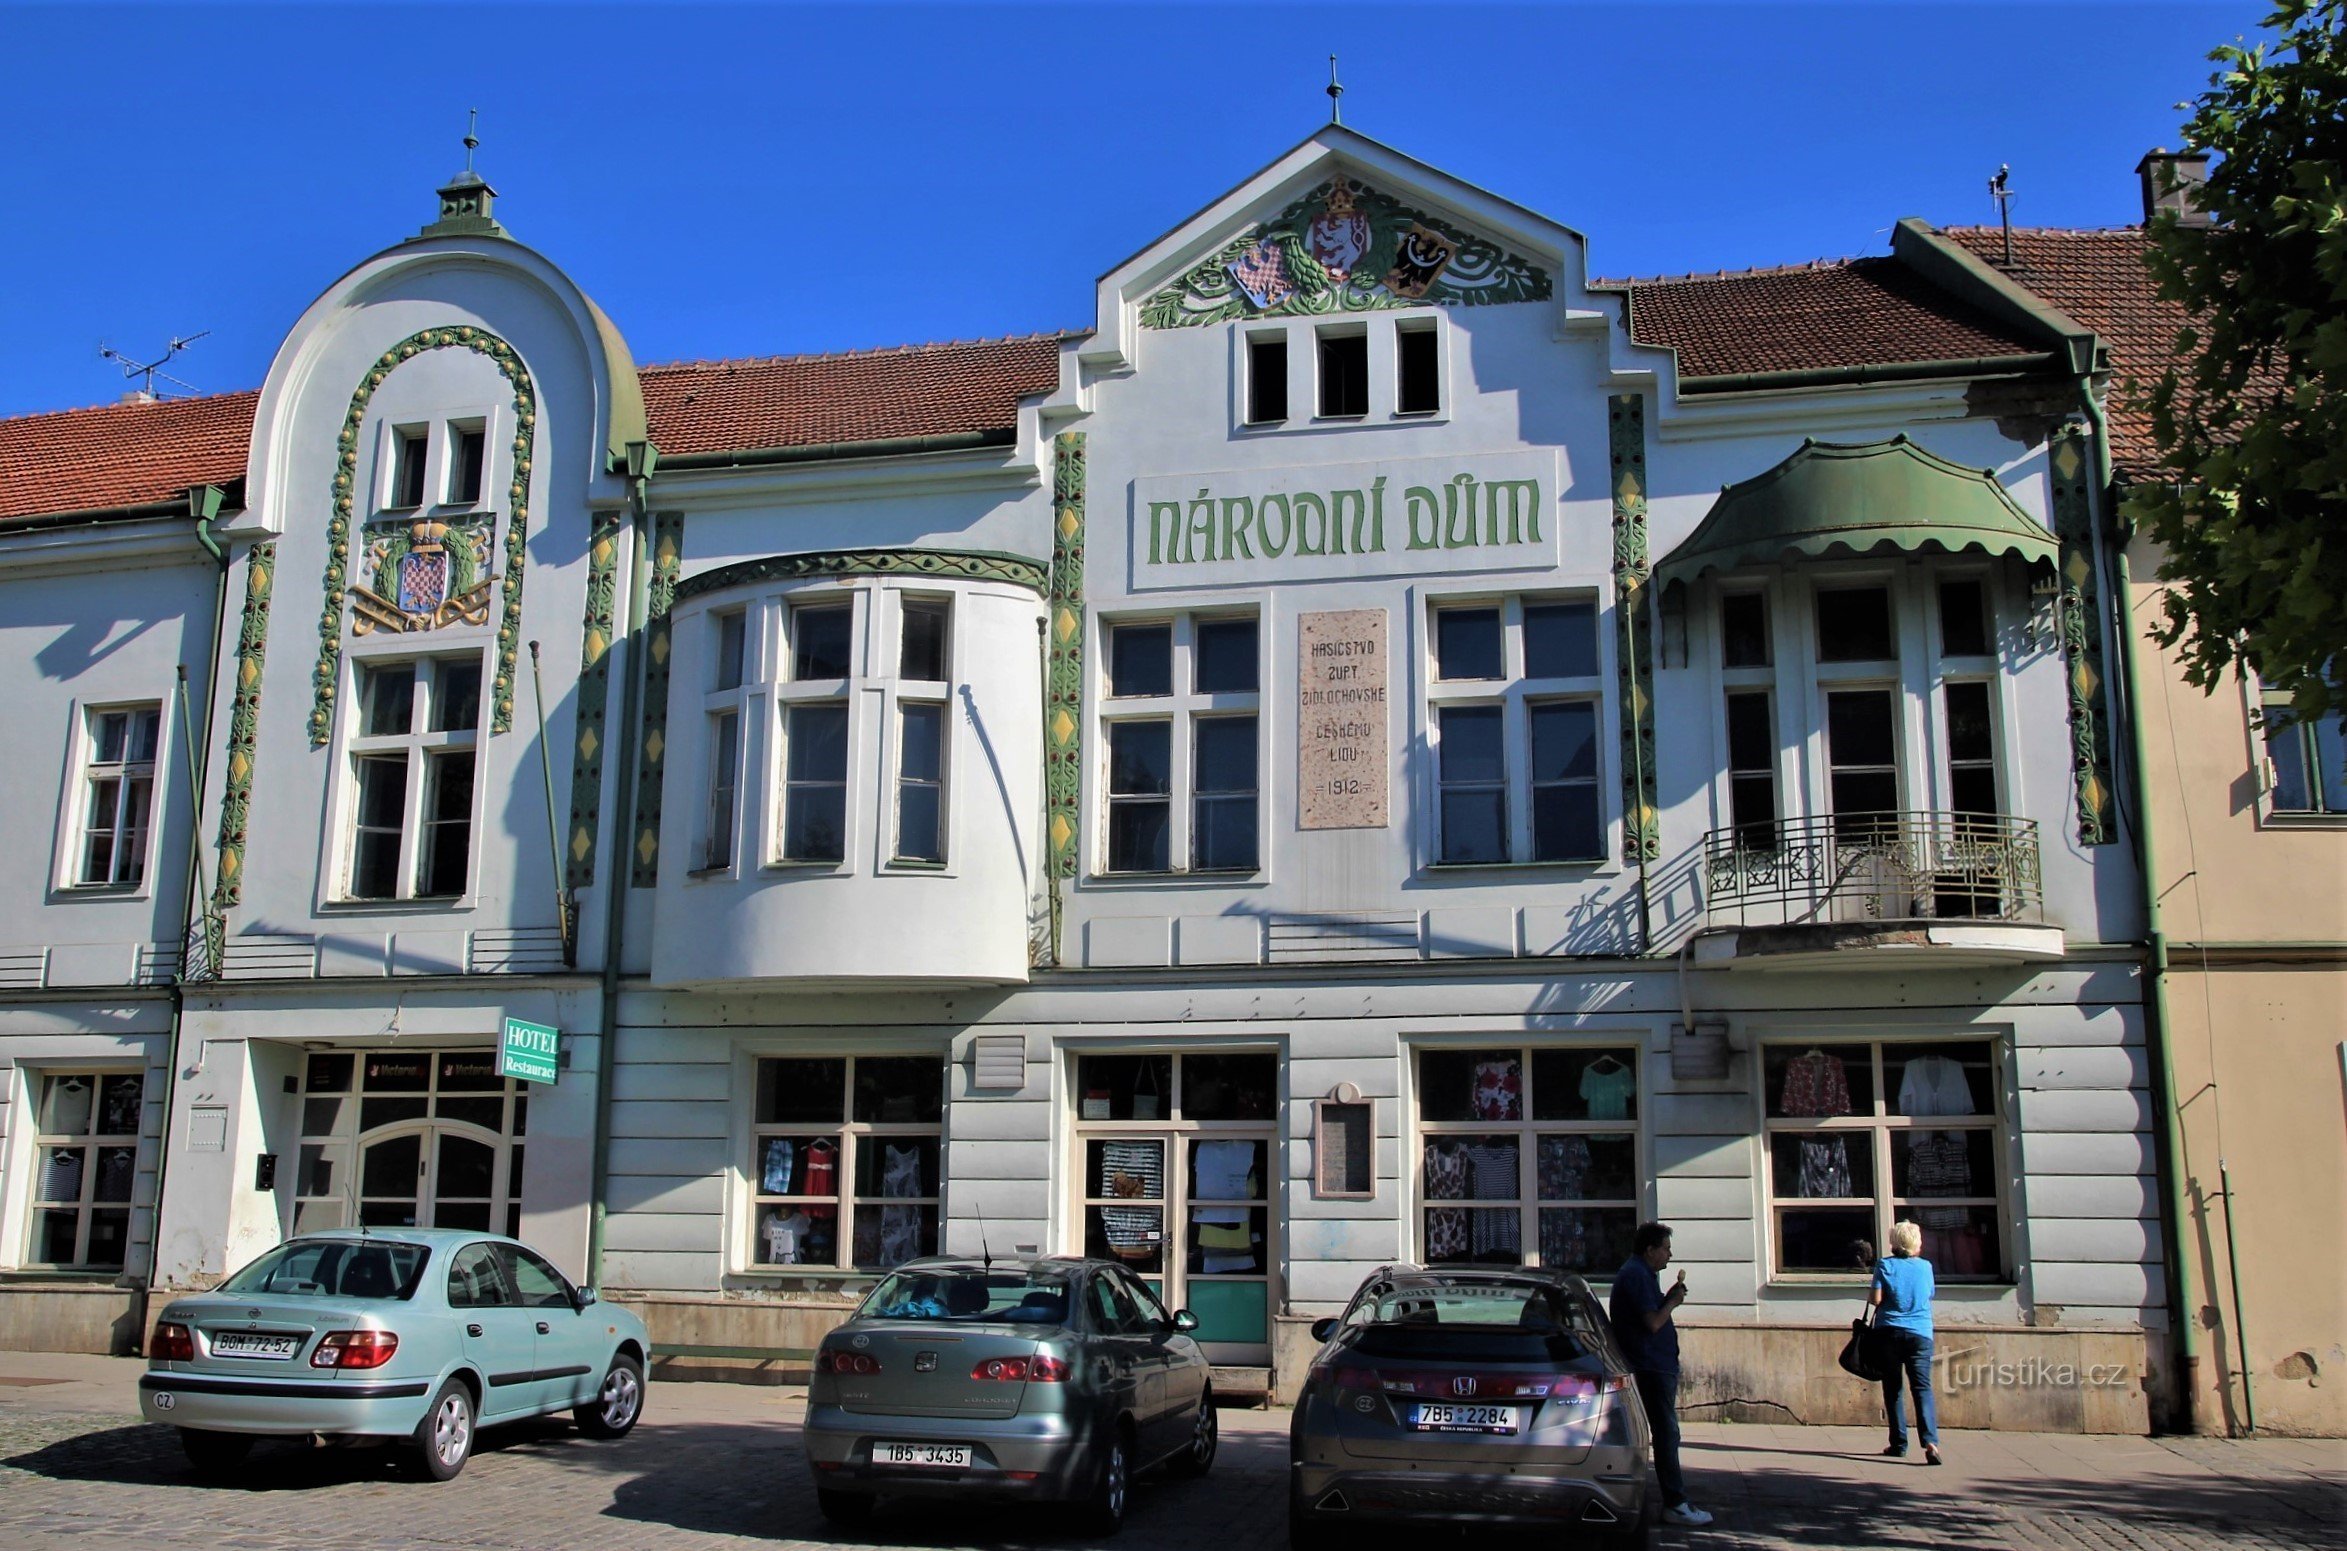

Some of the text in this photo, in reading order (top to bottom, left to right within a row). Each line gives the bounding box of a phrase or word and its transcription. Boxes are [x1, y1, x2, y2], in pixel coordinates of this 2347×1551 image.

[1147, 472, 1543, 565] NÁRODNÍ DŮM
[507, 1025, 557, 1054] HOTEL
[220, 1334, 246, 1351] BOM
[157, 1394, 171, 1409] CZ
[1422, 1405, 1509, 1425] 7B5 2284
[888, 1444, 964, 1464] 1B5 3435
